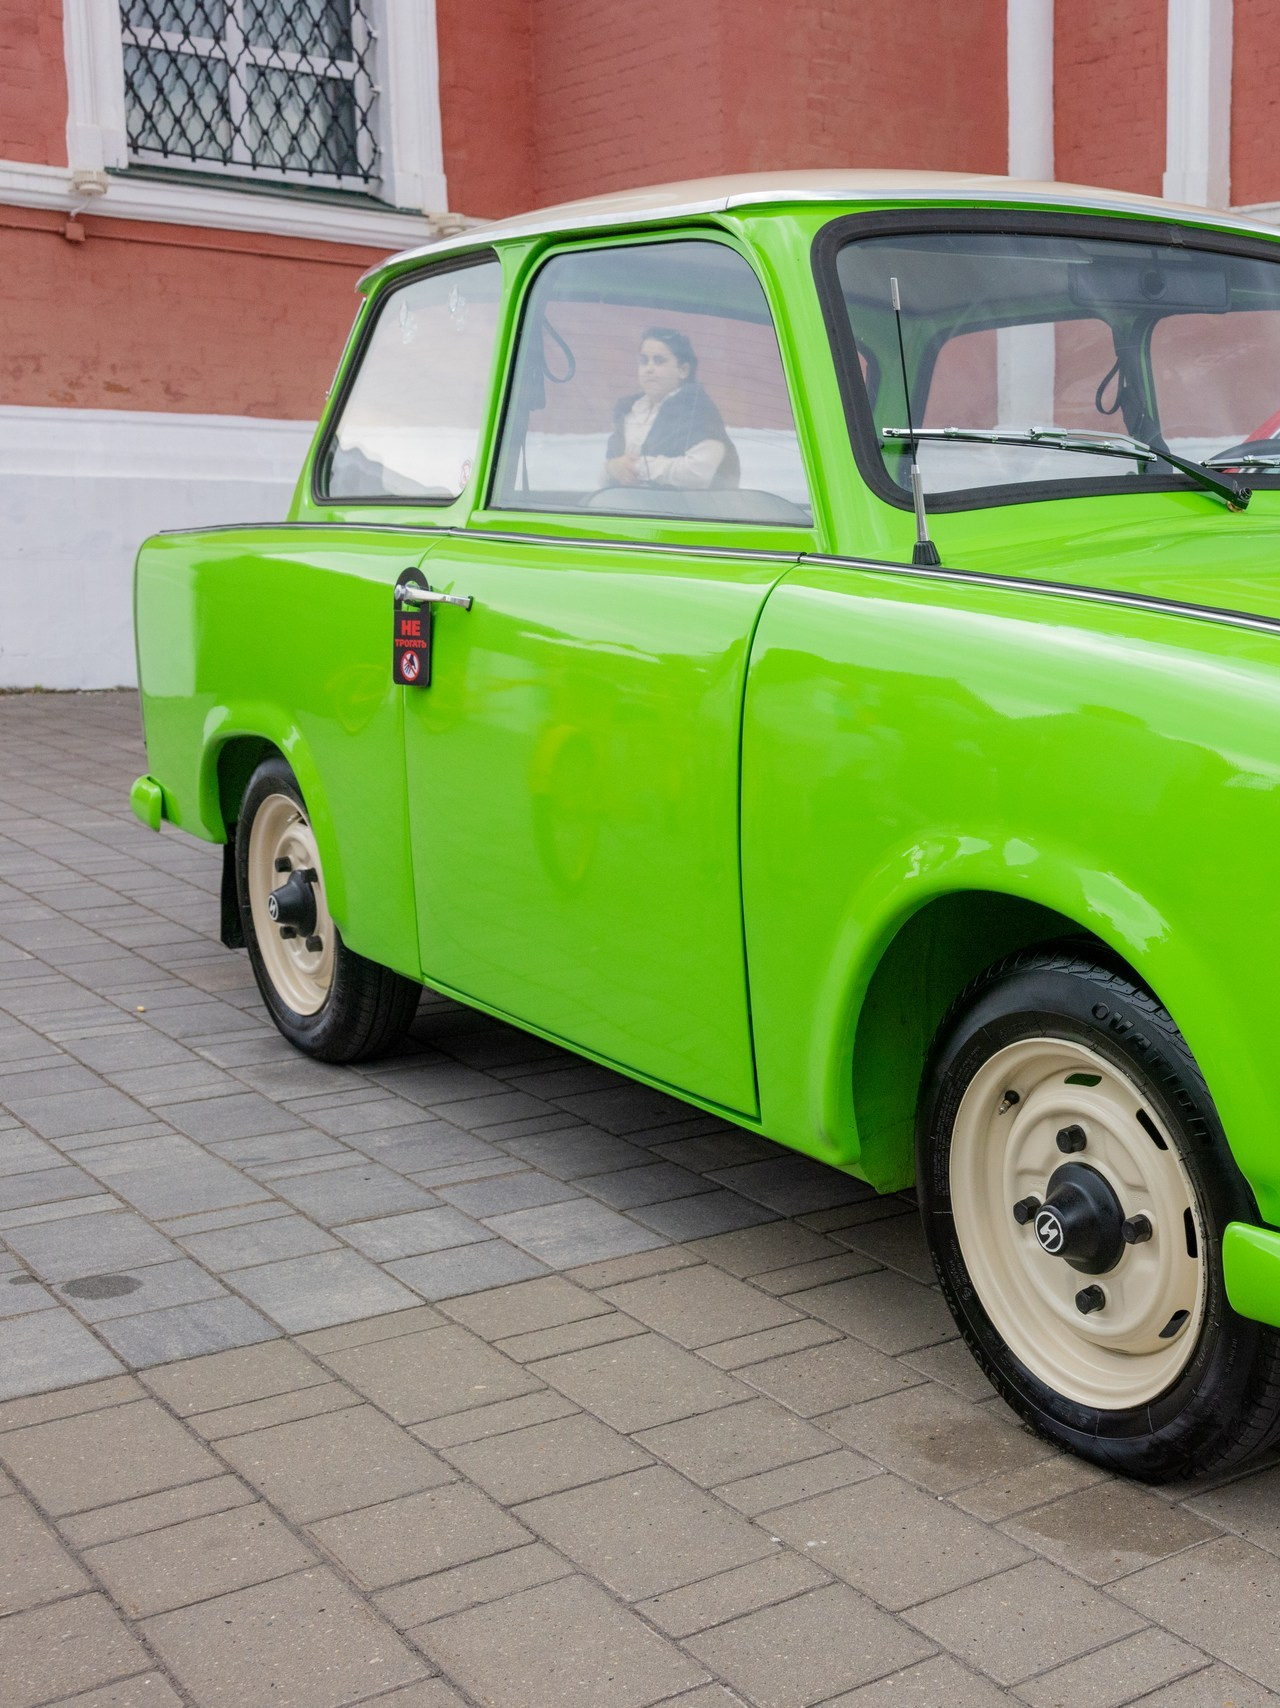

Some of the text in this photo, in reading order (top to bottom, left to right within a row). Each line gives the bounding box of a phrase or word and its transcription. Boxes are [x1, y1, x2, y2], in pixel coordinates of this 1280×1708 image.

[402, 620, 420, 636] НЕ
[396, 639, 427, 649] ТРОГАТЬ
[1091, 1001, 1216, 1146] OVATION
